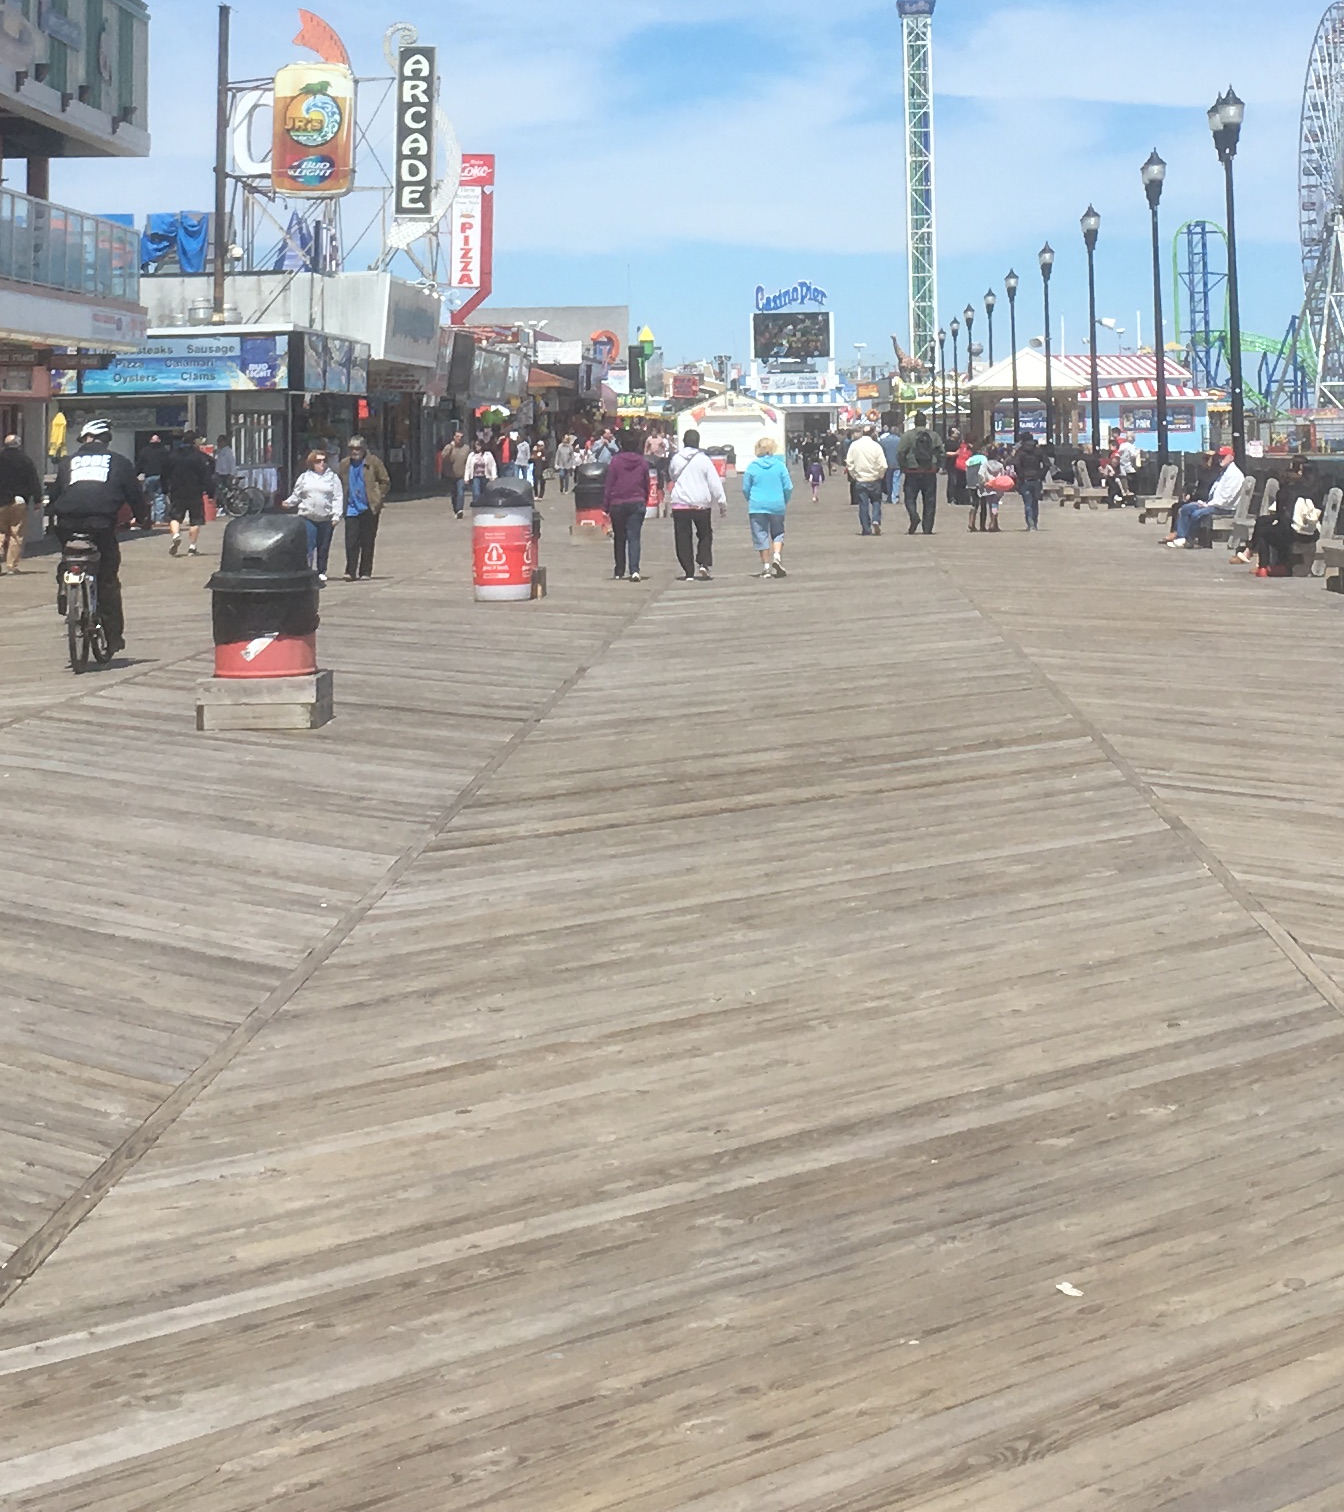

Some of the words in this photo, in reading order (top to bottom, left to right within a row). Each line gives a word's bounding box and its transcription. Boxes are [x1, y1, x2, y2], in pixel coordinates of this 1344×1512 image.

[401, 54, 430, 208] ARCADE
[301, 161, 330, 169] BUD
[294, 168, 333, 176] LIGHT
[457, 222, 474, 285] PIZZA
[755, 285, 799, 311] Casino
[798, 280, 827, 305] Pier
[186, 344, 236, 355] Sausage
[115, 359, 145, 369] Pizza
[165, 359, 216, 368] Calamari
[113, 373, 158, 384] Oysters
[181, 372, 216, 381] Clams
[246, 369, 272, 378] LIGHT
[70, 454, 112, 470] CODE
